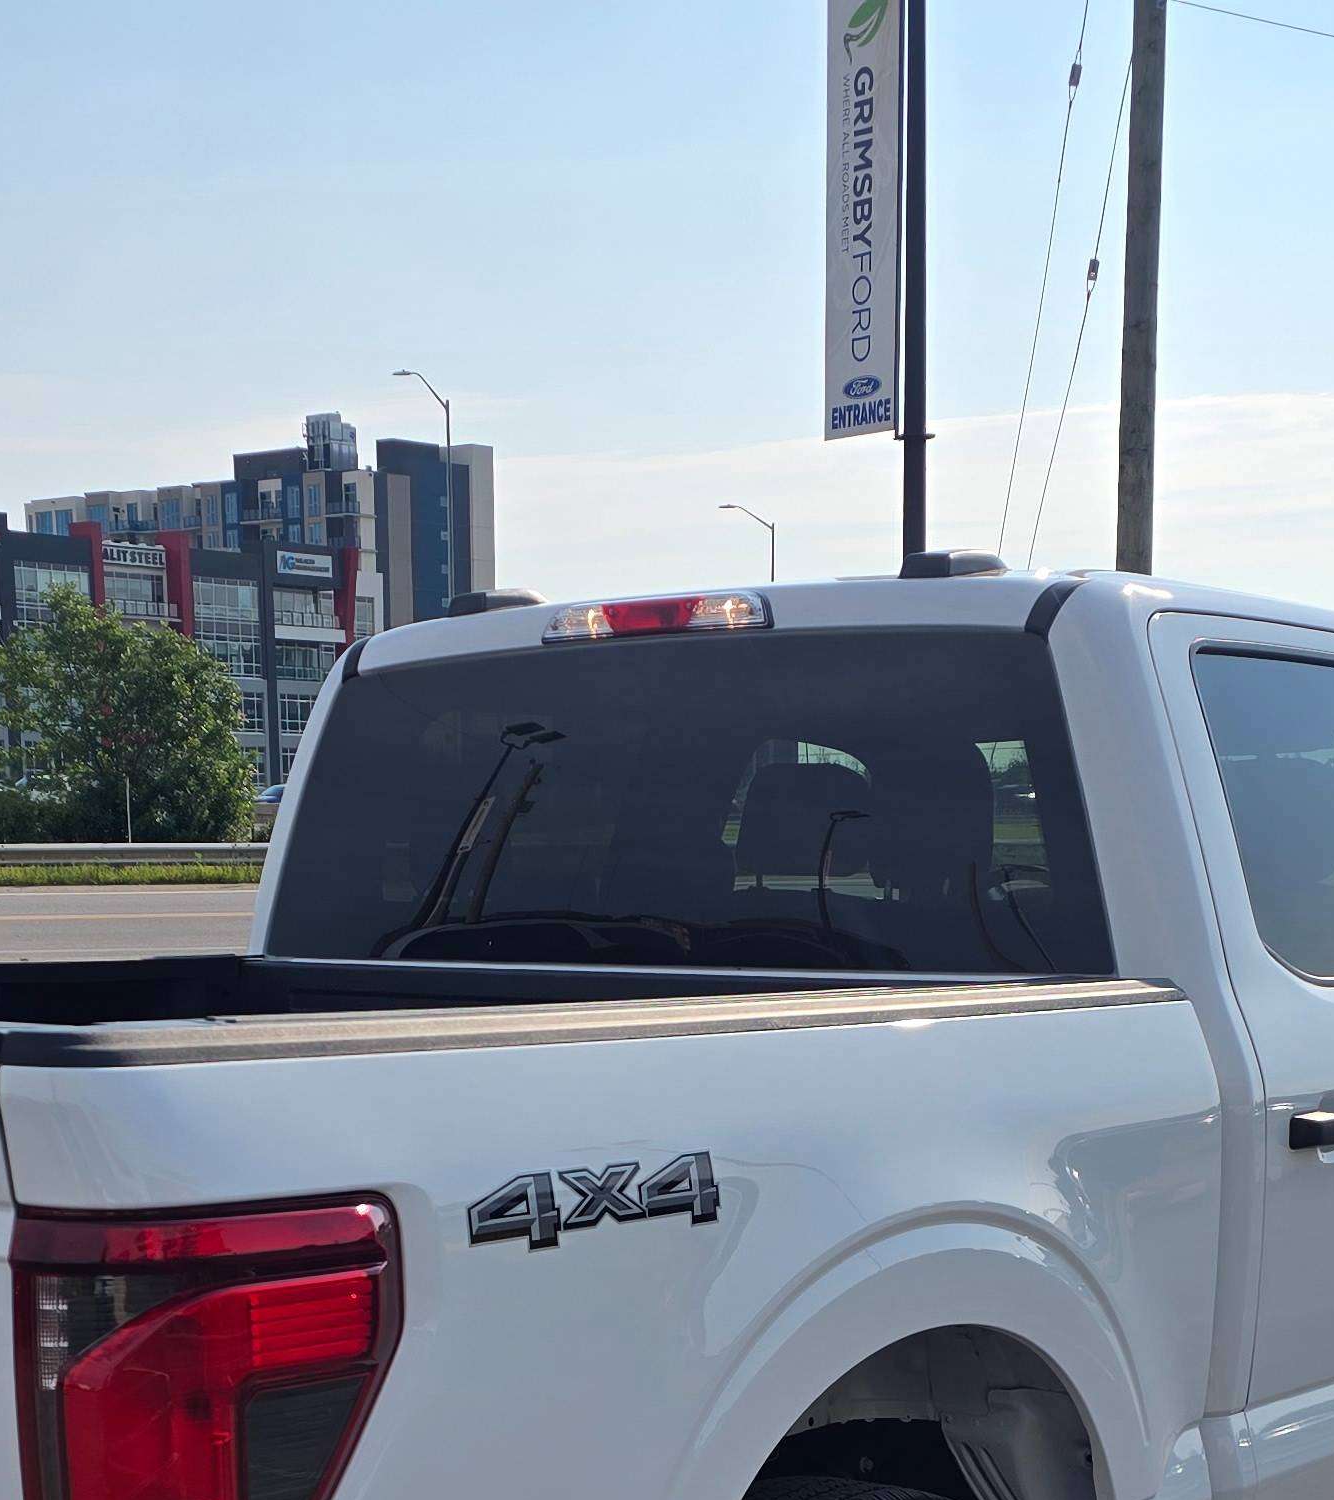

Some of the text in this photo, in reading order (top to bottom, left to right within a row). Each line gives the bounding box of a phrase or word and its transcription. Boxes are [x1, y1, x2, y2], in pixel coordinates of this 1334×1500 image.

[840, 74, 851, 253] WHERE ALL ROADS MEET
[852, 66, 874, 362] GRIMSBYFORD
[831, 398, 891, 430] ENTRANCE
